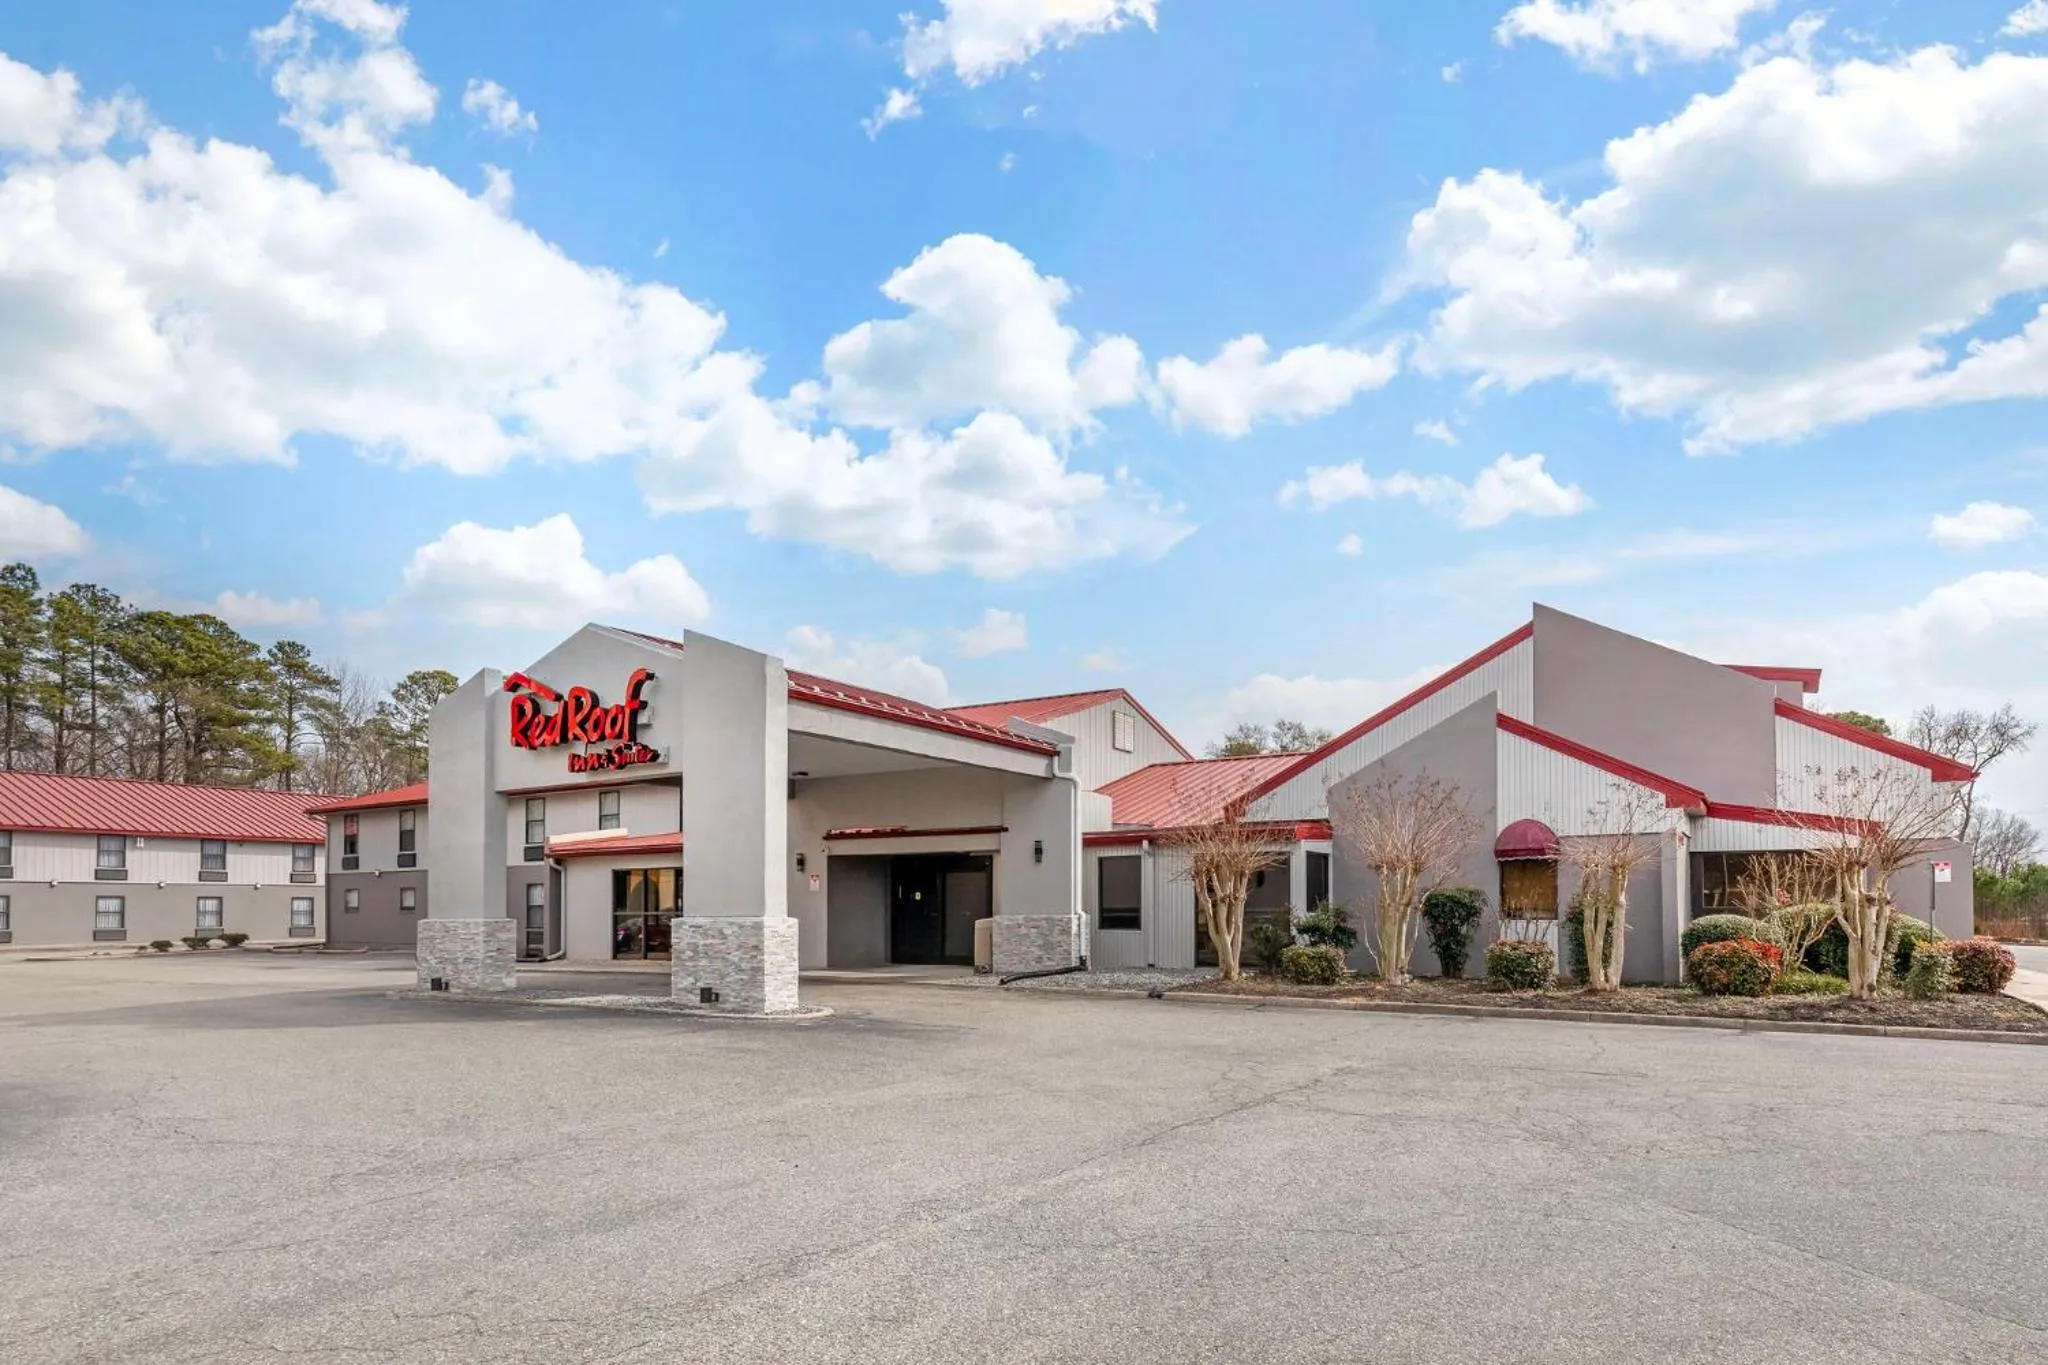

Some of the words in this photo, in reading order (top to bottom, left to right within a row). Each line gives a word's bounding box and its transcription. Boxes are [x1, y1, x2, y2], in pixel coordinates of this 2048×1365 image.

[510, 693, 567, 750] Red
[567, 667, 655, 745] Roof
[567, 751, 600, 773] Inn
